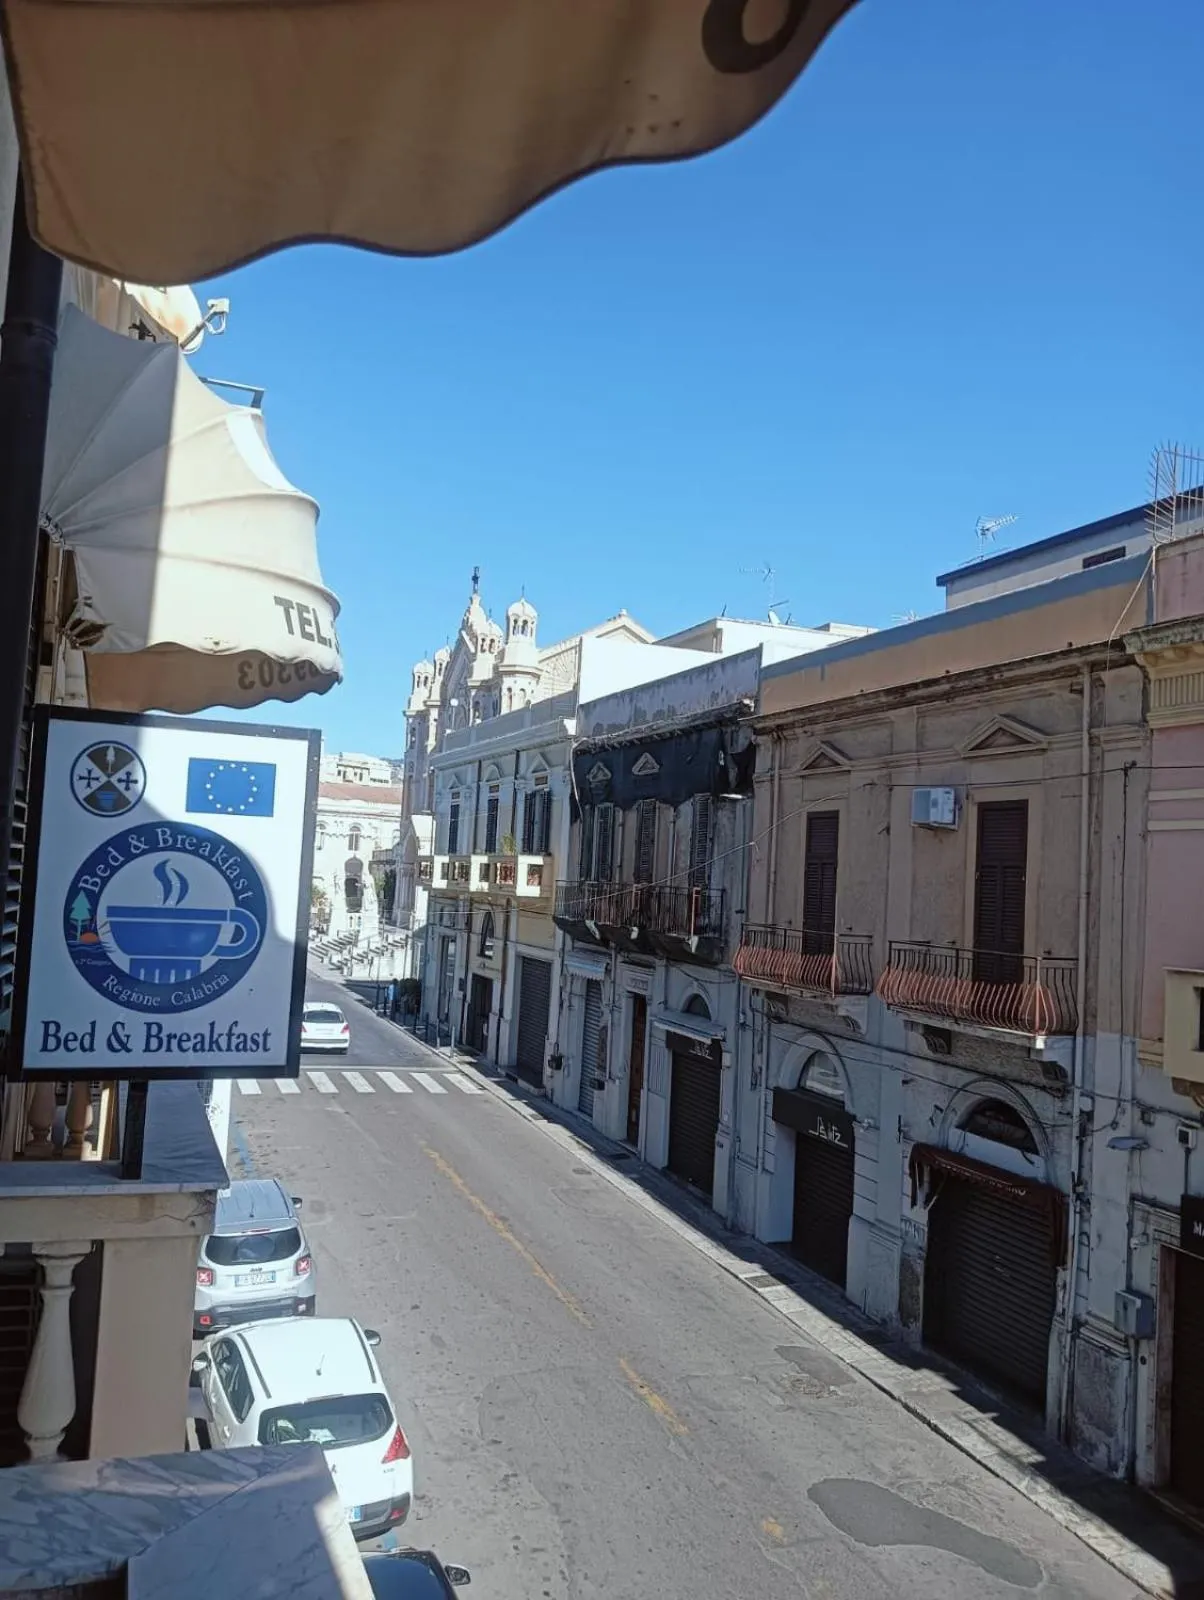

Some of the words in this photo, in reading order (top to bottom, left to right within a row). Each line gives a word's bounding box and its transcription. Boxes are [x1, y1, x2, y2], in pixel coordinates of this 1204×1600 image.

[78, 846, 125, 895] Bed
[128, 834, 149, 854] &
[155, 827, 254, 899] Breakfast
[102, 974, 161, 1006] Regione
[171, 974, 230, 1005] Calabria
[40, 1019, 97, 1053] Bed
[106, 1020, 133, 1053] &
[142, 1019, 272, 1053] Breakfast
